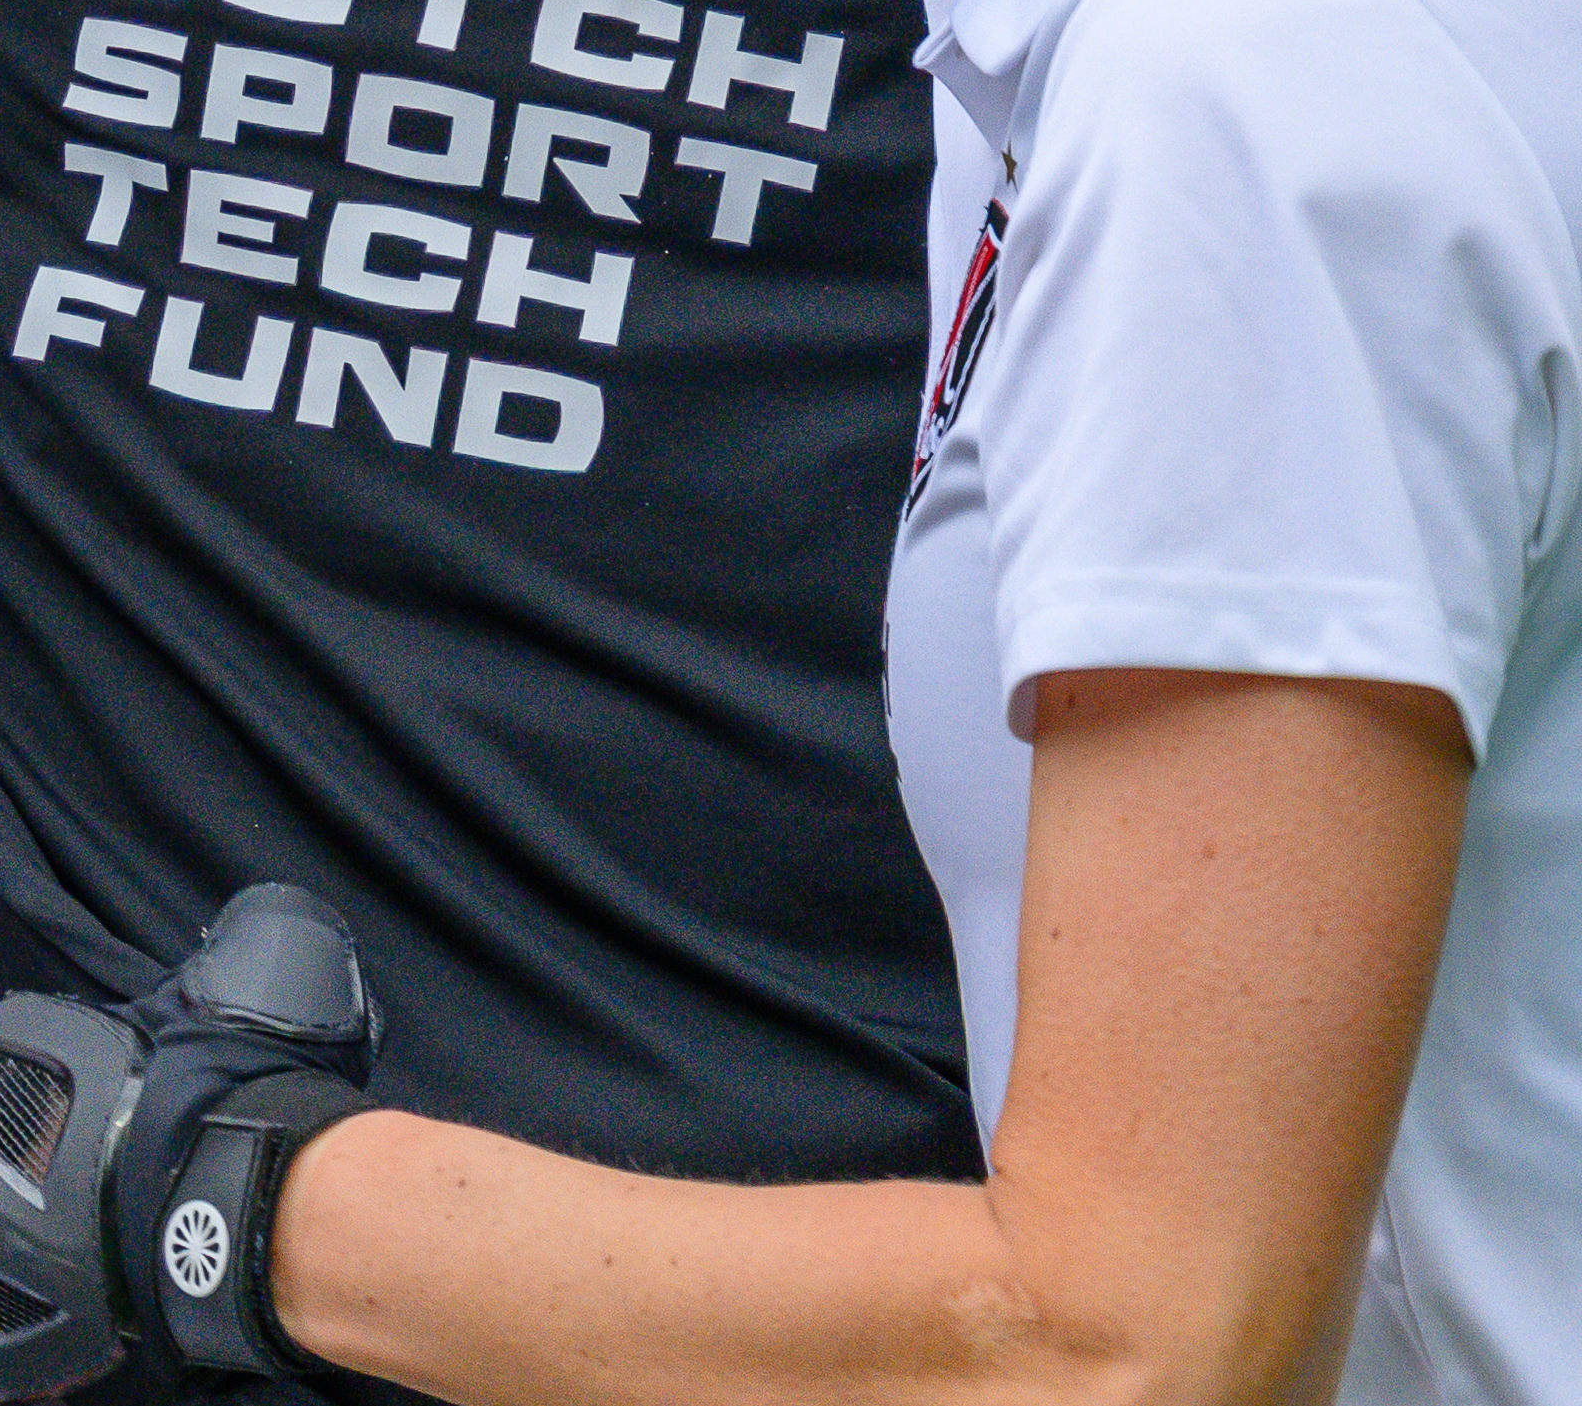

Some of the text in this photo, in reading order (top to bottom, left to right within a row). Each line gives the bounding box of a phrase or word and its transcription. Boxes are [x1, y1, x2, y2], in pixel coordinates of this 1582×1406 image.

[62, 17, 818, 245] SPORT
[64, 143, 635, 347] TECH
[12, 265, 604, 473] FUND
